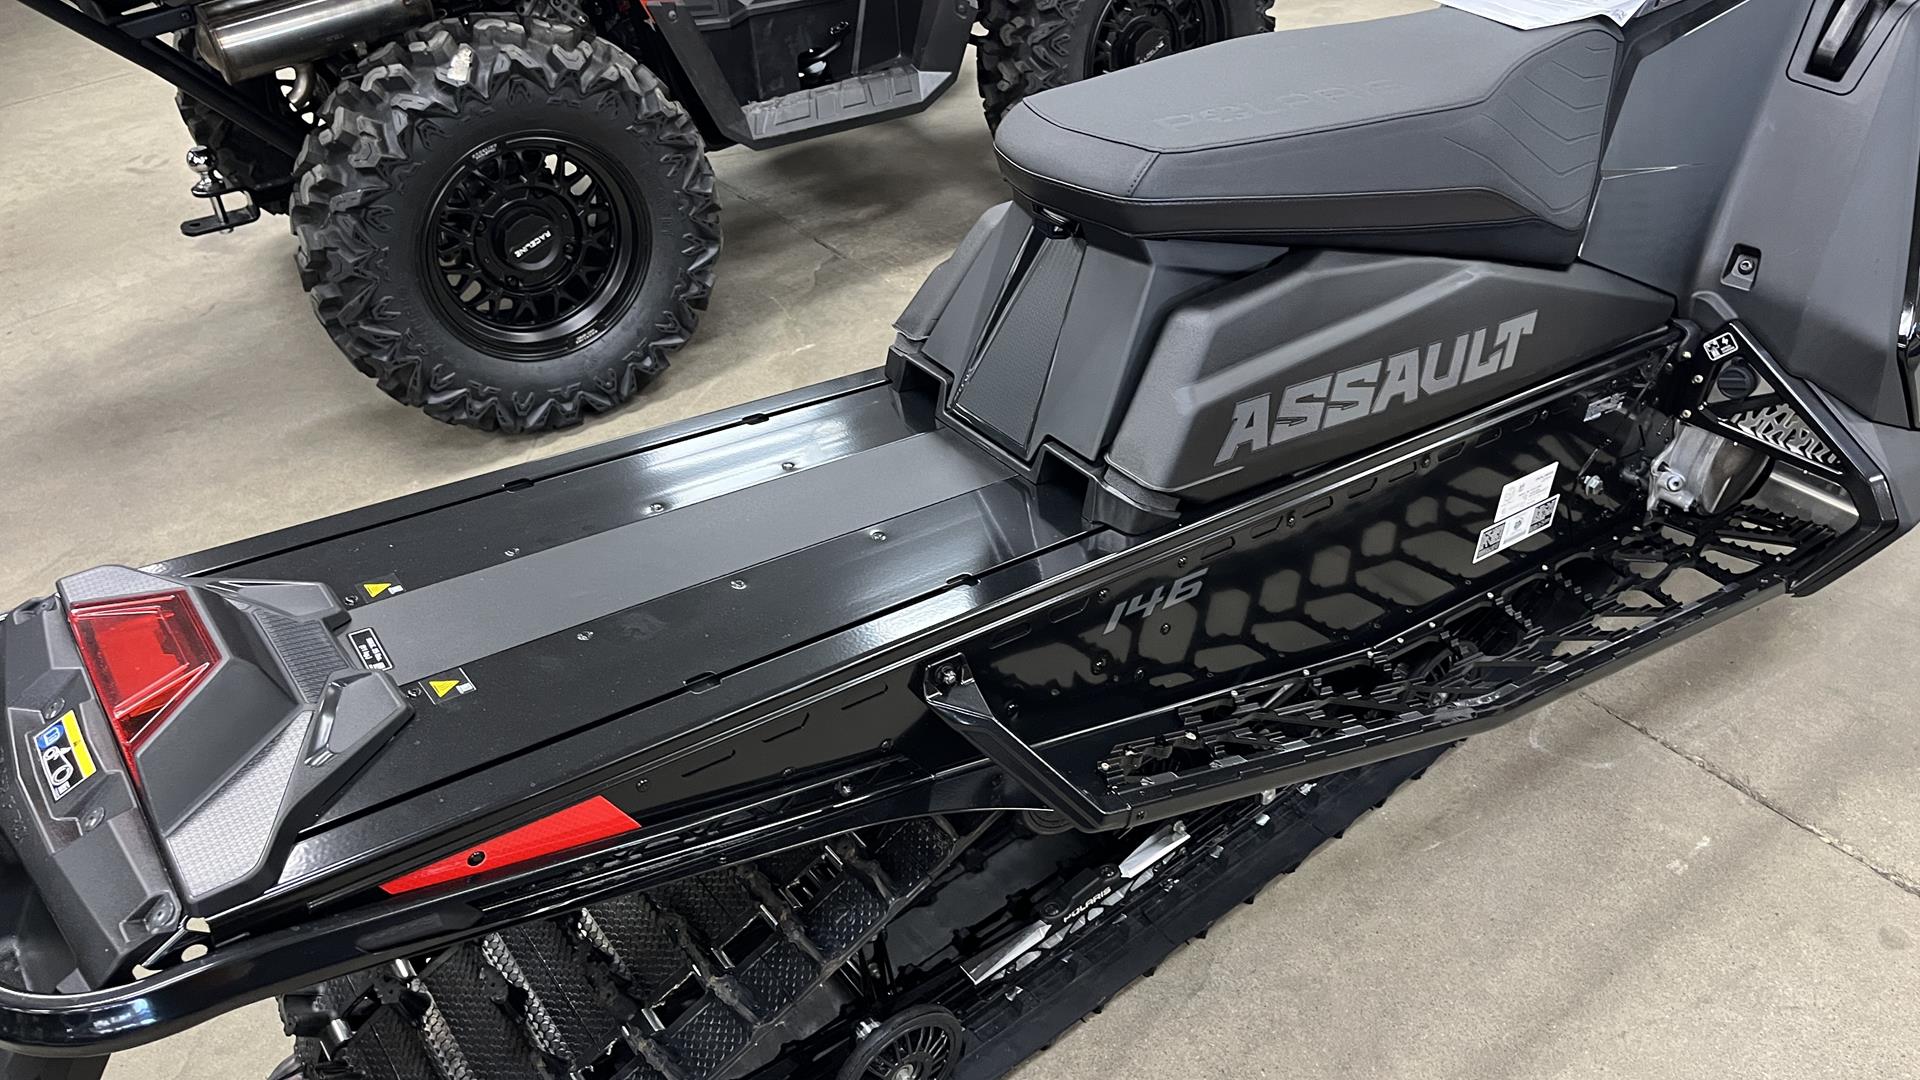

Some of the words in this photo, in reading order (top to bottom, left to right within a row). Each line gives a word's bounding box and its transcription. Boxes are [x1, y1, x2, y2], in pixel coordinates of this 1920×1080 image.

[514, 230, 552, 258] RACELINE
[1214, 309, 1538, 467] ASSAULT
[1103, 567, 1209, 635] 146
[1063, 886, 1112, 923] POLARIS
